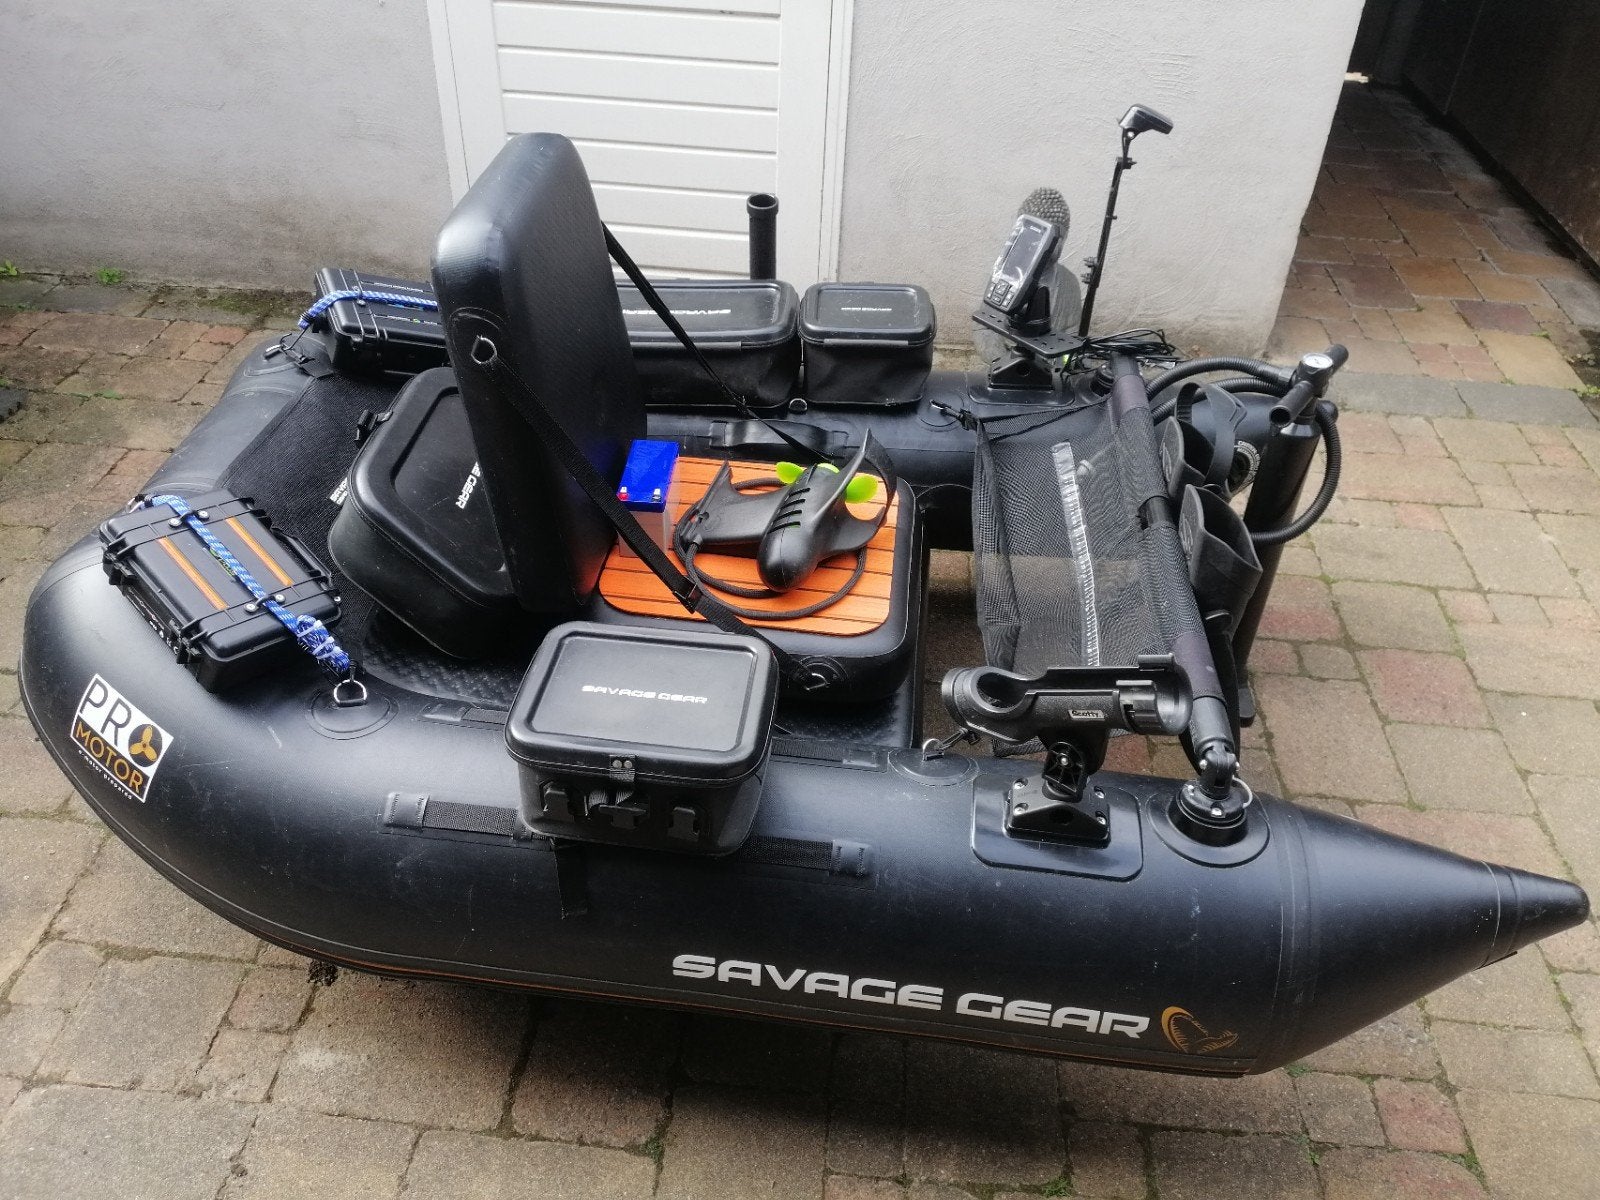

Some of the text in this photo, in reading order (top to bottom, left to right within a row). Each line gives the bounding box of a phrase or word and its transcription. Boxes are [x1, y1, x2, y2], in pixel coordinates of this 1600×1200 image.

[455, 474, 477, 510] GEAR
[581, 685, 708, 704] SAVAGE GEAR
[76, 720, 144, 794] MOTOR
[672, 954, 1151, 1039] SAVAGE GEAR
